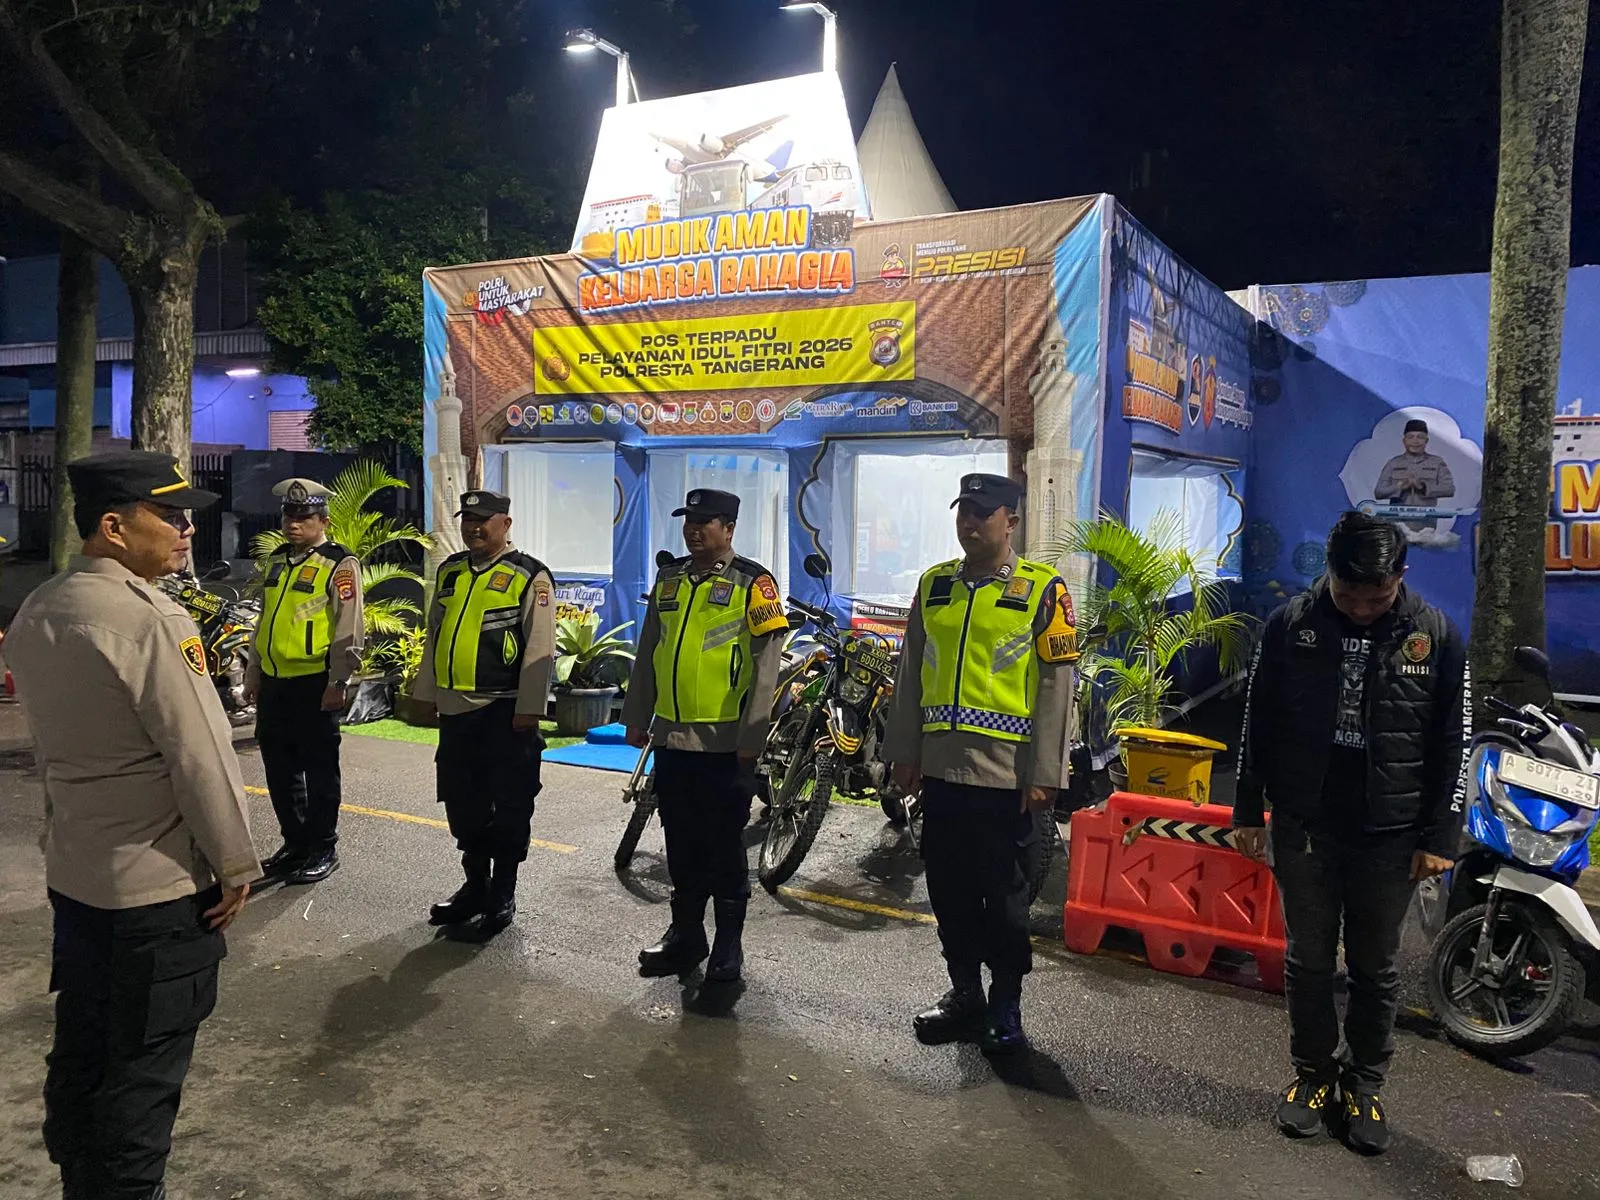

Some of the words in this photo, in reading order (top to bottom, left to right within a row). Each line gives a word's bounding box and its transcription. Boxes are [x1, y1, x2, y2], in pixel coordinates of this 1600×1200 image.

[616, 216, 712, 265] MUDIK
[713, 207, 809, 252] AMAN
[914, 246, 1027, 278] PRESISI
[478, 275, 504, 292] POLRI
[579, 260, 714, 312] KELUARGA
[718, 250, 853, 295] BAHAGIA
[478, 284, 511, 302] UNTUK
[478, 285, 545, 312] MASYARAKAT
[869, 319, 904, 330] BANTEN
[641, 333, 679, 348] POS
[685, 327, 777, 346] TERPADU
[578, 349, 685, 365] PELAYANAN
[691, 346, 735, 361] IDUL
[741, 341, 792, 358] FITRI
[799, 337, 853, 354] 2026
[600, 362, 694, 378] POLRESTA
[701, 355, 825, 375] TANGERANG
[857, 406, 897, 417] mandiri
[922, 403, 943, 411] BANK
[944, 401, 958, 410] BRI
[556, 587, 569, 600] ari
[574, 587, 602, 606] Raya
[1402, 664, 1430, 675] POLISI
[1506, 755, 1514, 768] A
[1526, 761, 1561, 780] 6077
[1450, 747, 1471, 813] POLRESTA
